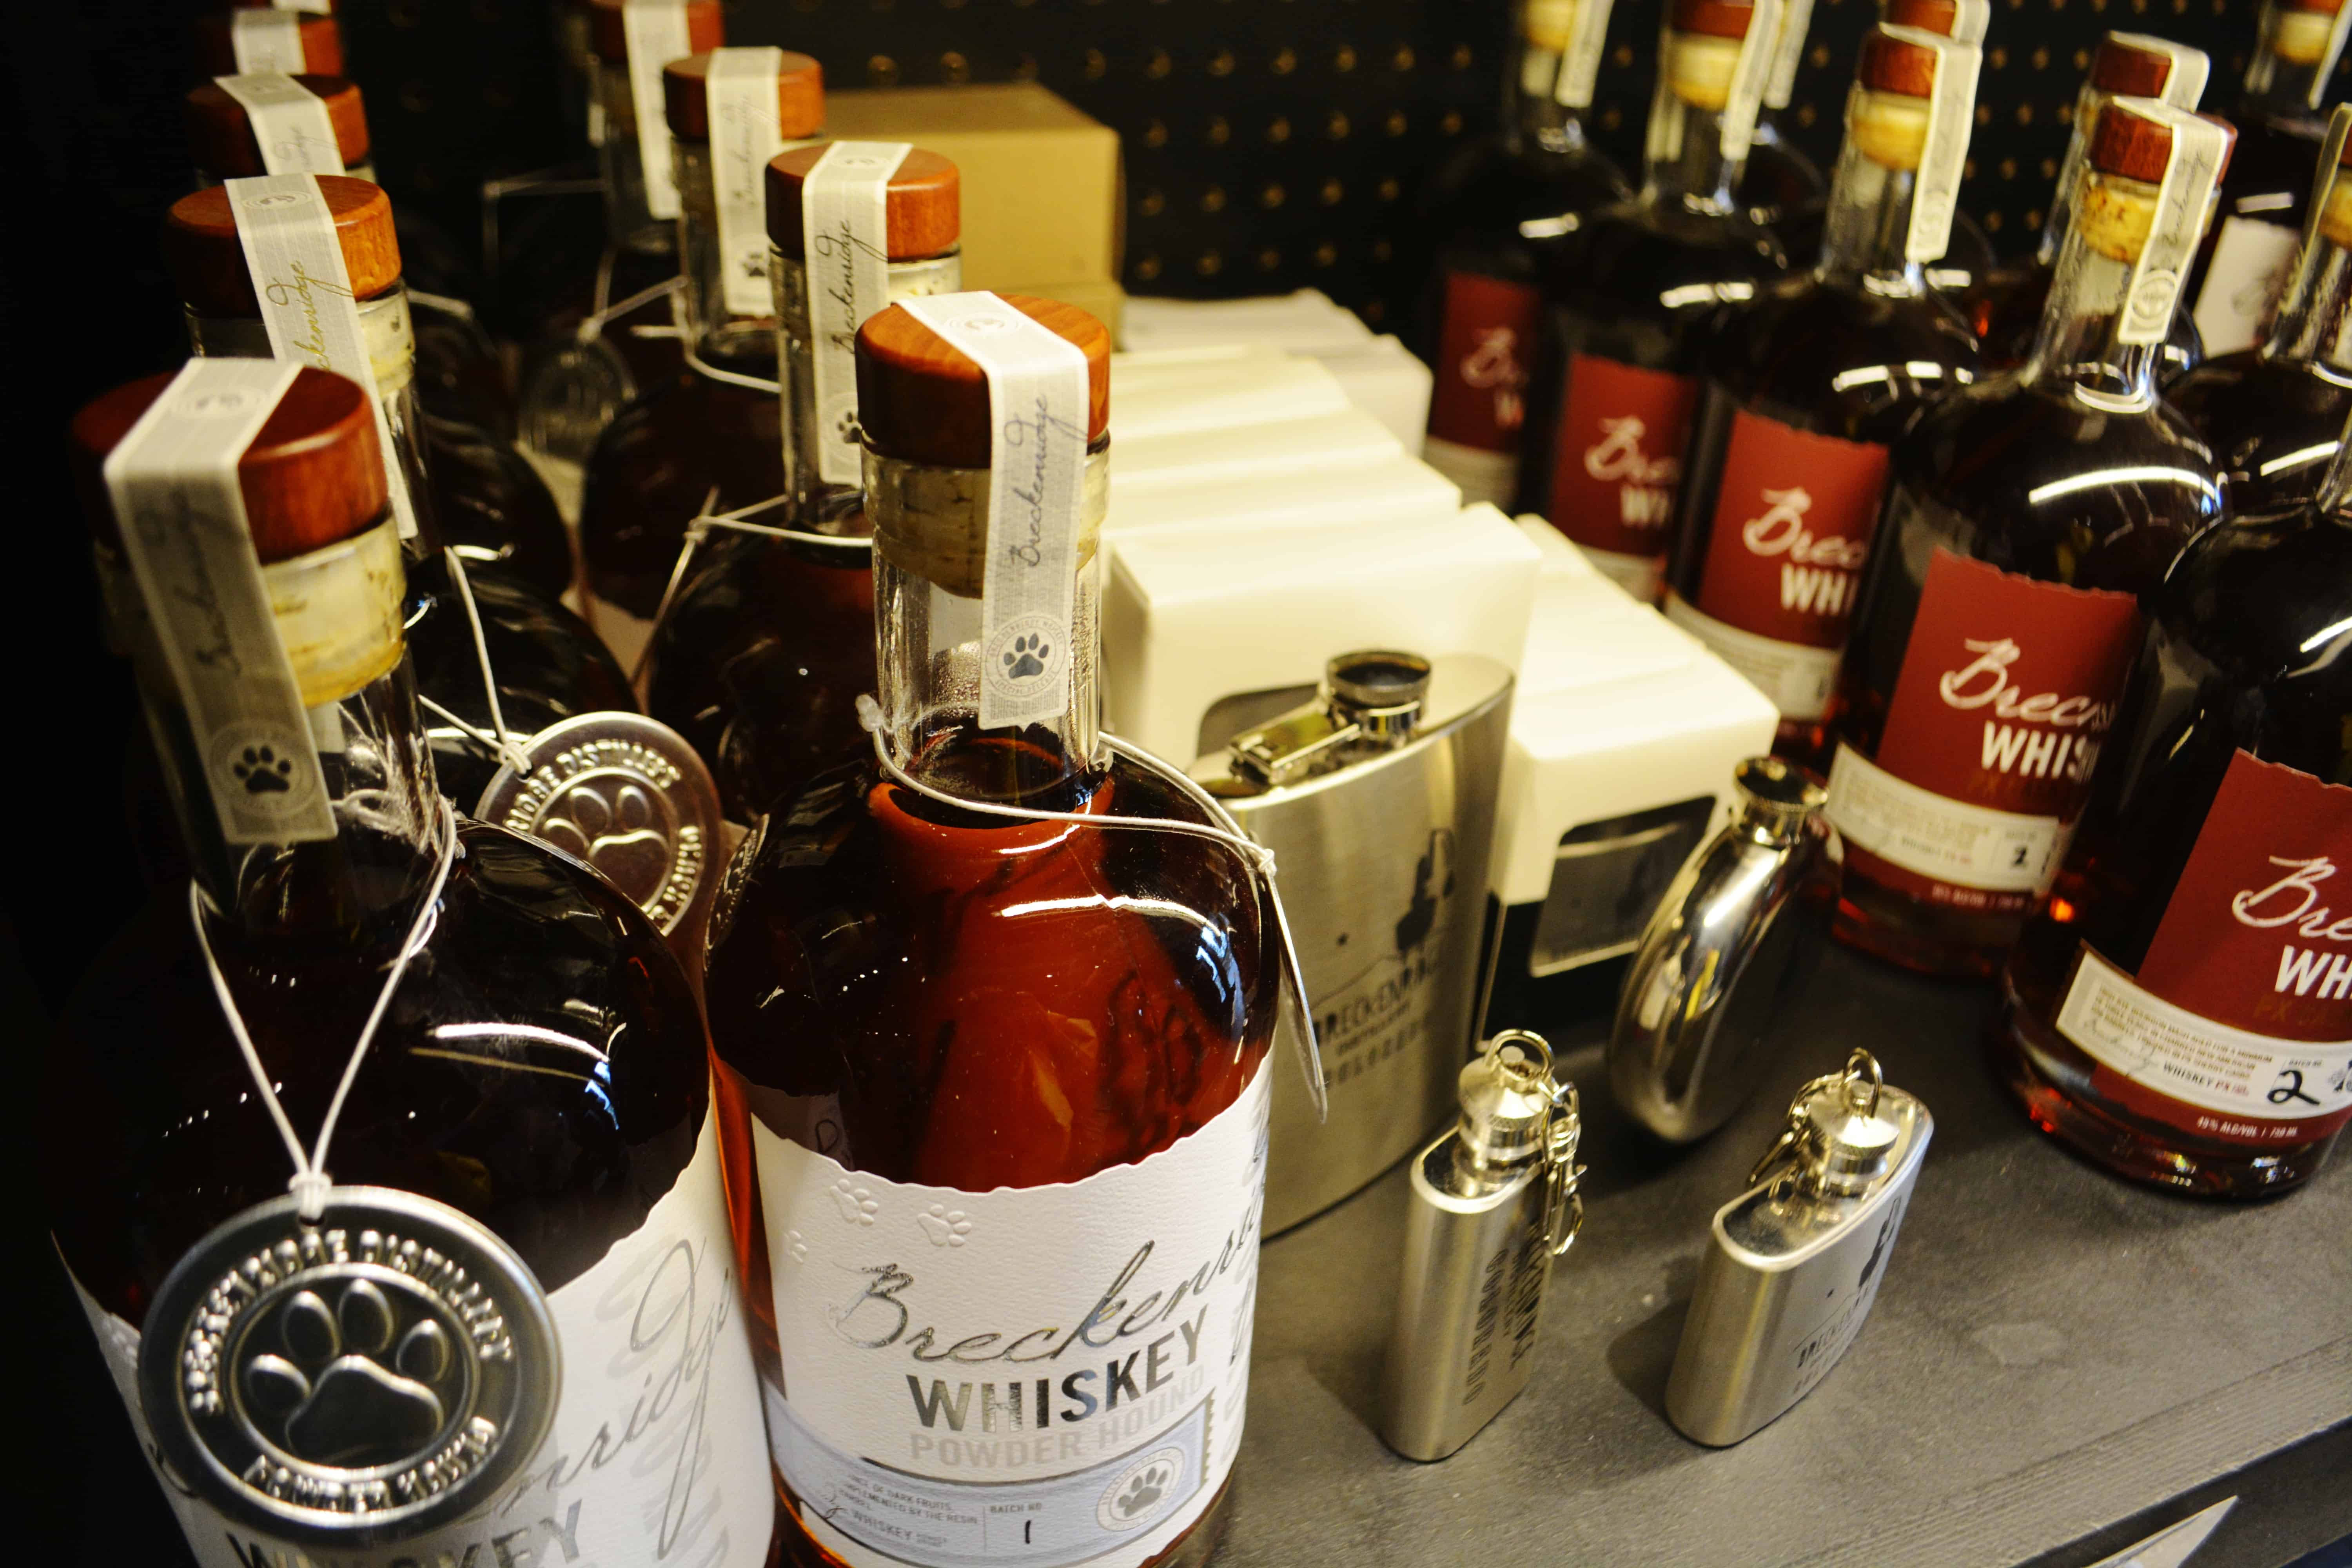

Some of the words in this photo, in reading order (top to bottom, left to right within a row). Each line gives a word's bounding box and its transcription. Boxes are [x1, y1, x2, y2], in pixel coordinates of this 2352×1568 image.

[1004, 393, 1088, 567] Breckenridge
[1742, 487, 1868, 569] Brec
[2275, 944, 2352, 1000] WH
[2267, 1070, 2321, 1104] 2
[905, 1304, 1209, 1433] WHISKEY
[909, 1425, 1082, 1468] POWDER
[1098, 1363, 1205, 1449] HOUND
[852, 1510, 913, 1540] WHISKEY
[946, 1513, 978, 1525] RESIN
[990, 1504, 1024, 1514] BATCH
